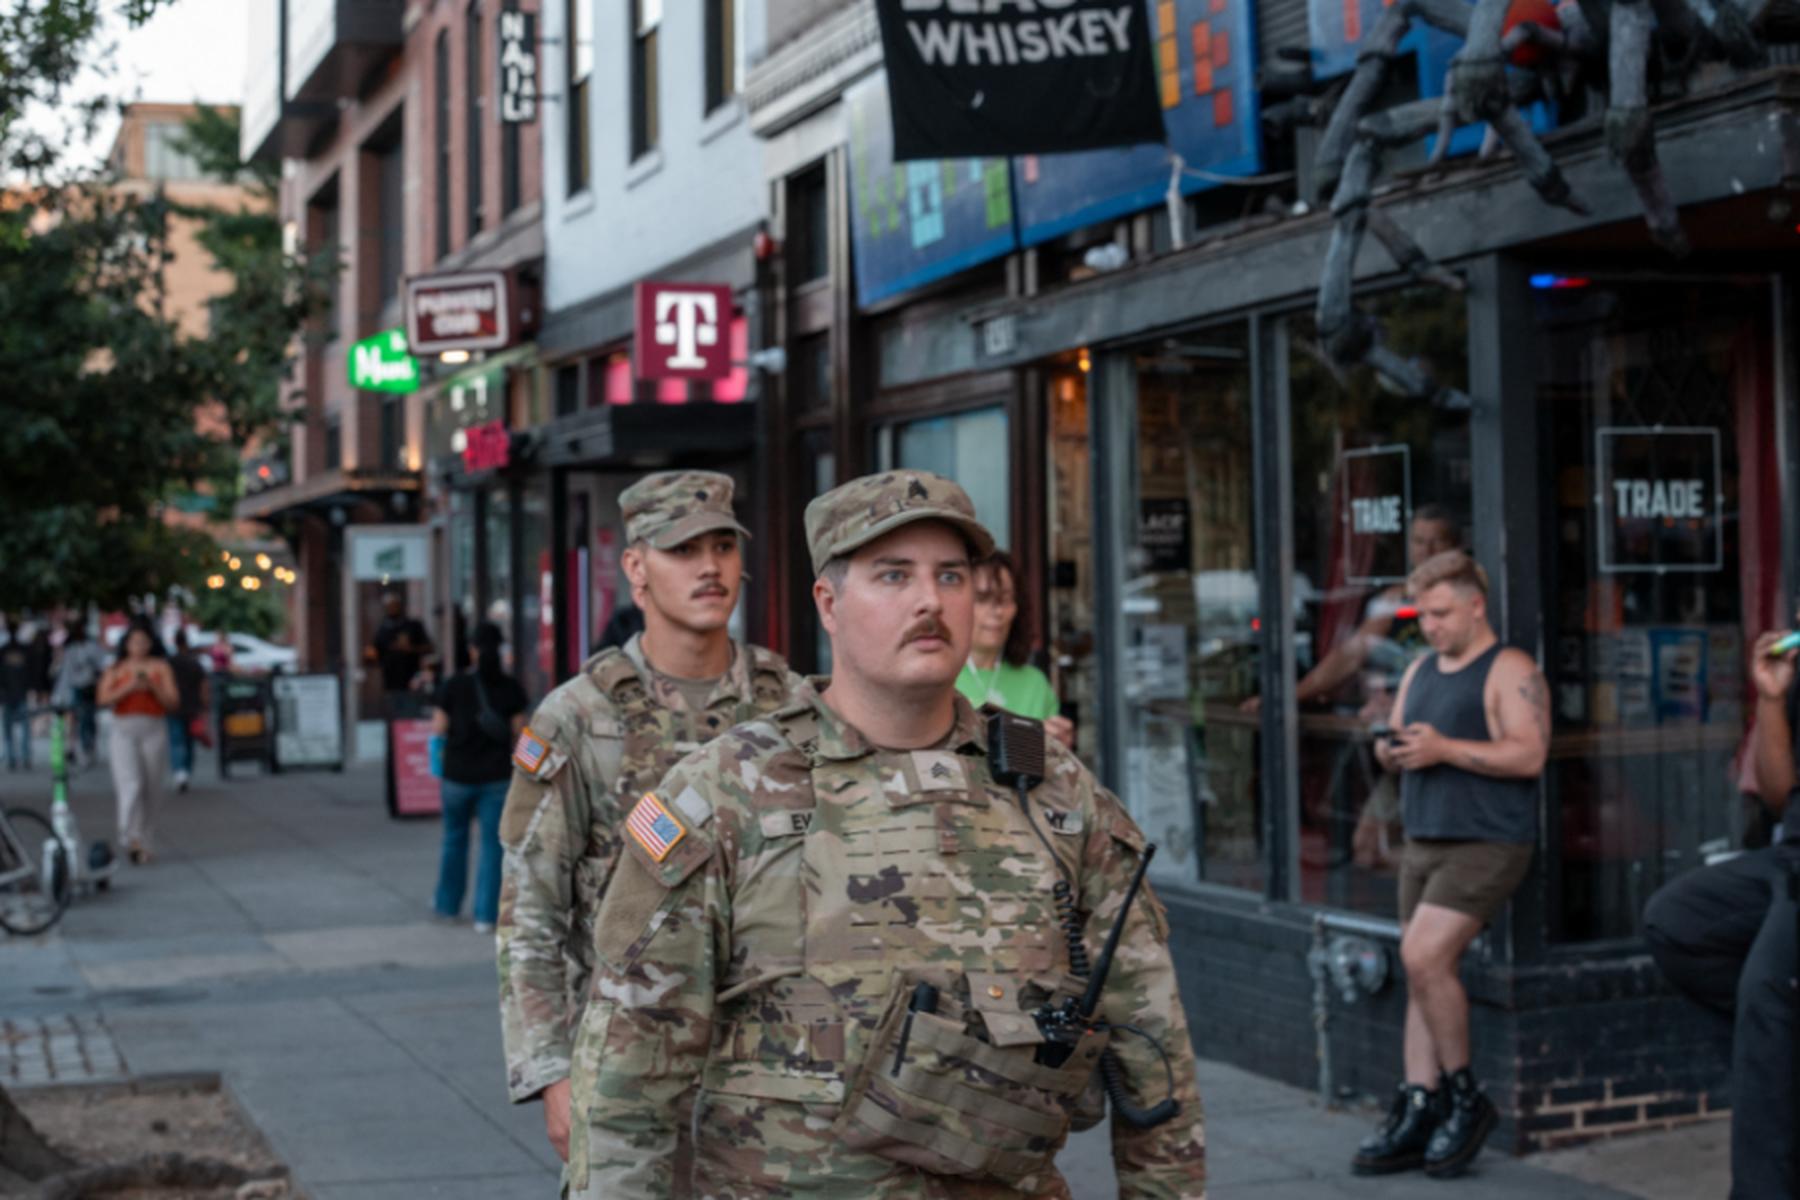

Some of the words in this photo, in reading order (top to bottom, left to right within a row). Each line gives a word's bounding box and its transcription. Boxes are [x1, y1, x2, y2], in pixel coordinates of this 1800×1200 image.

[906, 7, 1132, 66] WHISKEY
[502, 12, 524, 120] NAIL
[656, 290, 717, 369] T
[1352, 496, 1401, 533] TRADE
[1613, 479, 1704, 518] TRADE
[791, 813, 812, 831] EV
[1044, 811, 1069, 829] MY
